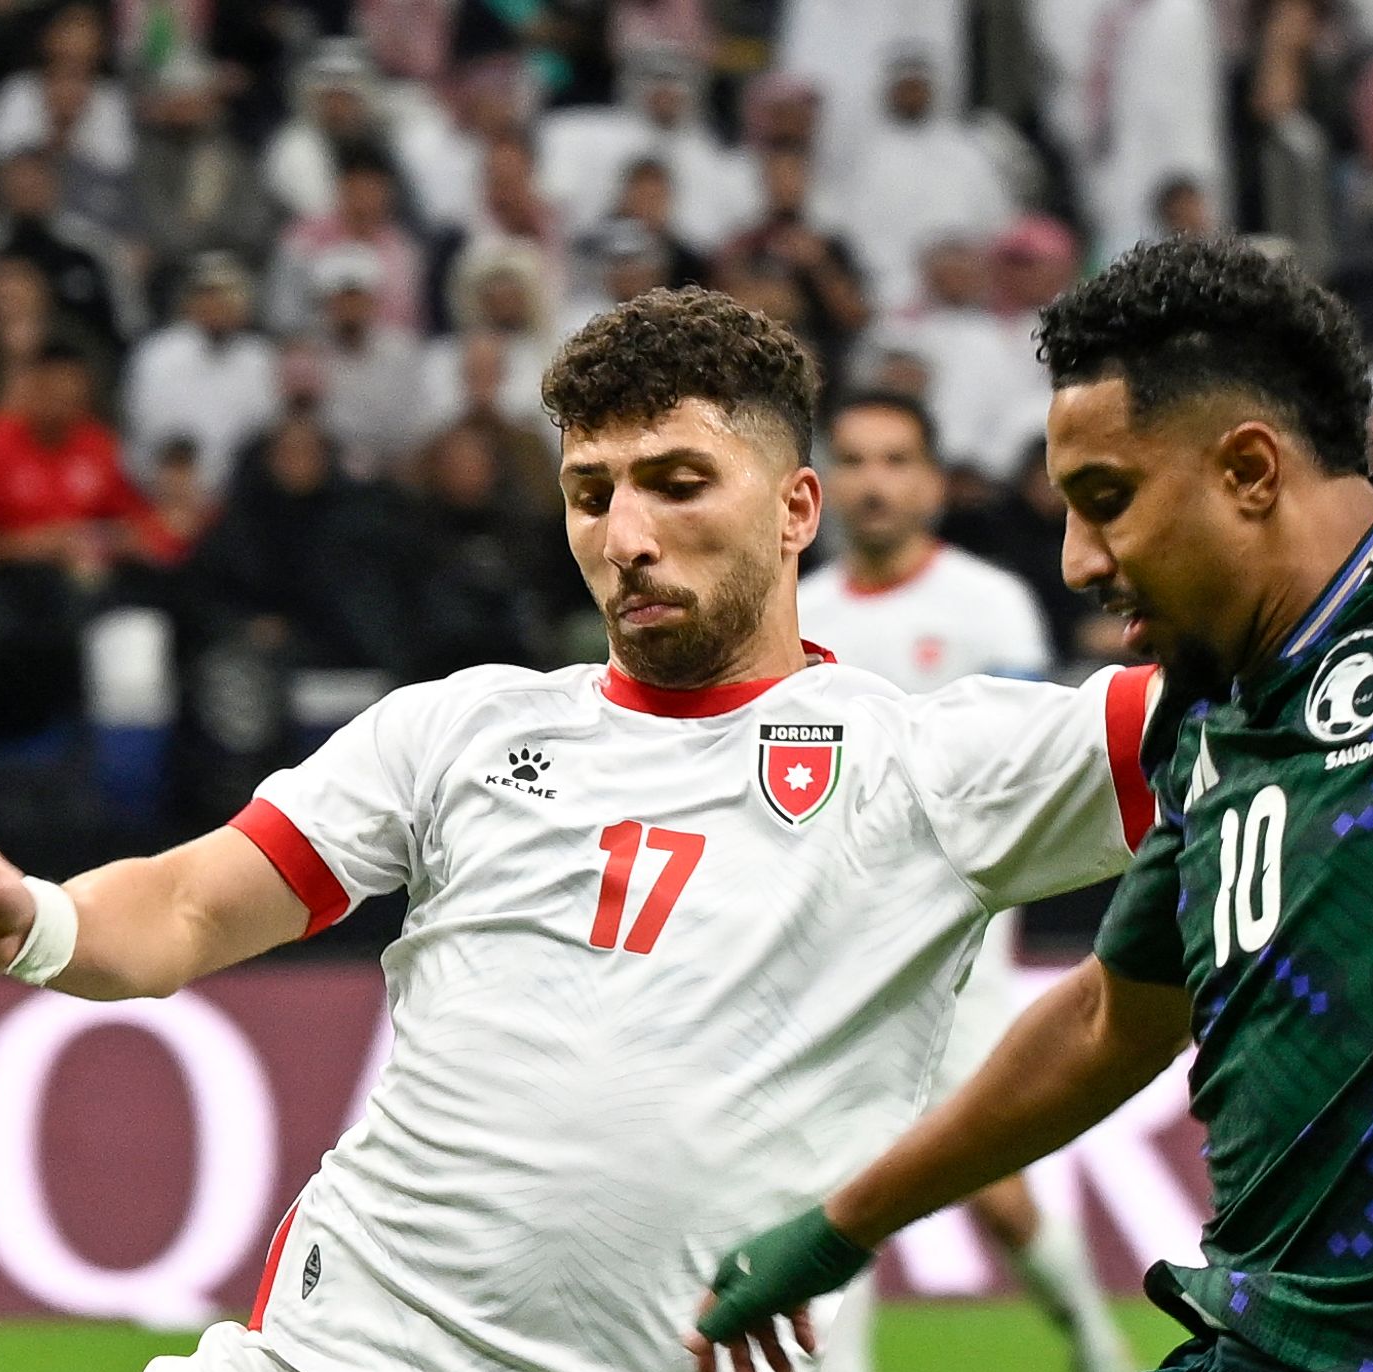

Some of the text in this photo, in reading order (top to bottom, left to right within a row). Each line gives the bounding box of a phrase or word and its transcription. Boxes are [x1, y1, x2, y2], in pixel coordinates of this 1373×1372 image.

[769, 726, 834, 741] JORDAN
[485, 774, 558, 800] KELME
[589, 820, 706, 955] 17
[1214, 785, 1287, 968] 10
